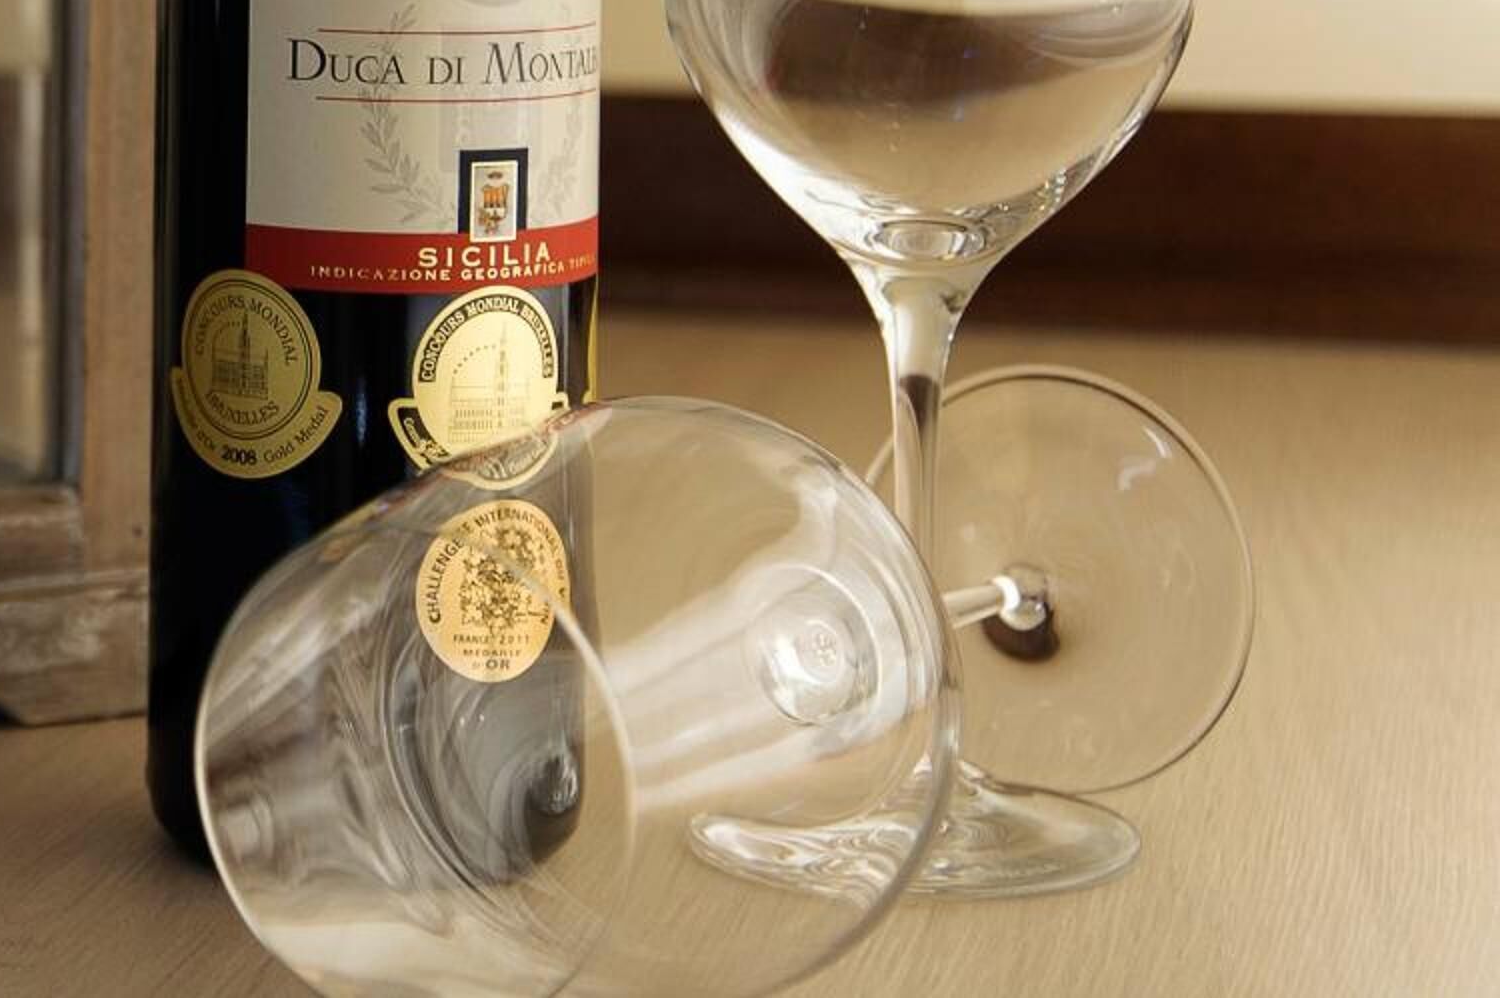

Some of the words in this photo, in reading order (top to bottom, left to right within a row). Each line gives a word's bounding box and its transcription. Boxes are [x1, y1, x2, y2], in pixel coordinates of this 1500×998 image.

[287, 38, 408, 85] DUCA
[427, 55, 468, 85] DI
[309, 264, 451, 282] INDICAZIONE
[460, 260, 565, 282] GEOGRAFICA
[418, 242, 551, 267] SICILIA
[248, 298, 299, 367] MONDIAL
[420, 309, 466, 382] CONCOURS
[465, 296, 521, 317] MONDIAL
[221, 443, 258, 466] 2008
[263, 438, 295, 463] Gold
[294, 404, 330, 444] Medal
[427, 535, 465, 625] CHALLENGE
